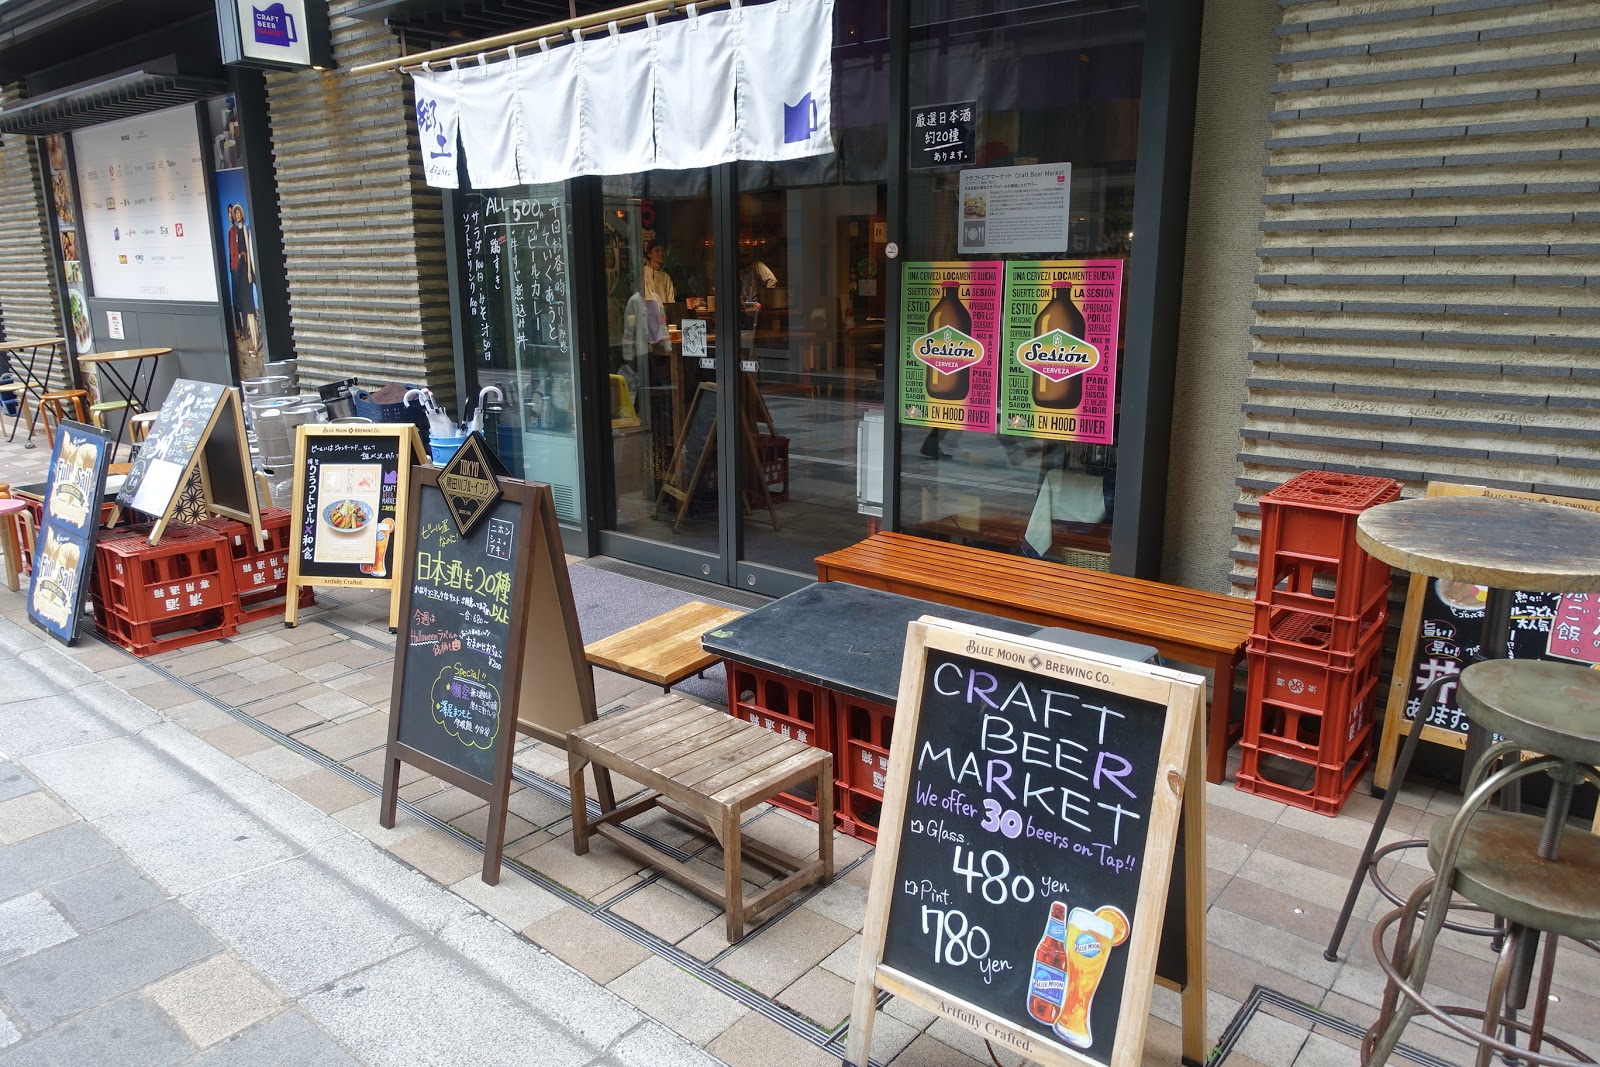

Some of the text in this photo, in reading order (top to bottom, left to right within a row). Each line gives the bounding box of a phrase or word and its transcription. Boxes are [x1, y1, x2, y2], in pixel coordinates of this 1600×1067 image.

[256, 13, 280, 23] CRAFT
[257, 20, 277, 30] BEER
[915, 107, 971, 128] 厳選日本酒
[924, 127, 960, 145] 約20種
[933, 149, 968, 162] あります。
[1014, 171, 1029, 179] Craft
[485, 197, 509, 217] ALL
[907, 271, 997, 281] UNA CERVEZA LOCAMENTE BUENA
[1012, 271, 1115, 281] UNA CERVEZA LOCAMENTE BUENA
[907, 287, 940, 296] SUERTE CON
[961, 288, 971, 297] LA
[1012, 288, 1050, 298] SUERTE CON
[1074, 287, 1115, 298] LA SESIÓN
[907, 301, 930, 313] ESTILO
[968, 302, 995, 311] APROBADA
[1011, 302, 1038, 315] ESTILO
[1081, 303, 1112, 313] APROBADA
[972, 312, 995, 320] POR LAS
[1087, 314, 1112, 323] POR LAS
[1009, 330, 1031, 338] SUPREMA
[919, 338, 976, 358] Sesión
[1024, 343, 1090, 364] Sesión
[935, 360, 959, 368] CERVEZA
[1009, 366, 1024, 374] ML
[972, 370, 992, 378] PARA
[1042, 367, 1070, 375] CERVEZA
[1008, 377, 1029, 389] CUELLO
[1085, 376, 1108, 385] PARA
[1008, 388, 1029, 396] CORTO
[969, 398, 991, 406] SABOR
[931, 405, 990, 424] EN HOOD RIVER
[1082, 406, 1107, 414] SABOR
[1037, 415, 1105, 435] EN HOOD RIVER
[460, 459, 480, 478] TOKYO
[56, 460, 72, 484] Full
[76, 467, 93, 497] Sail
[382, 485, 397, 493] CRAFT
[420, 518, 451, 540] ビール屋
[490, 524, 511, 536] ニホン
[39, 555, 76, 598] Full Sail
[252, 566, 286, 585] 清酒
[323, 578, 364, 586] Artfully Crafted.
[165, 592, 203, 612] 清酒
[413, 608, 436, 626] 今週は
[1516, 618, 1550, 632] 大人気
[1431, 640, 1460, 656] 早い!
[966, 639, 994, 658] BLUE
[997, 648, 1026, 665] MOON
[1045, 659, 1093, 681] BREWING
[933, 662, 1126, 745] CRAFT
[981, 713, 1137, 799] BEER
[917, 740, 1141, 845] MARKET
[915, 780, 1136, 875] We offer 30 beers on Tap!!
[952, 845, 1070, 905] 480 yen
[921, 904, 1013, 985] 780 yen
[1074, 942, 1101, 953] BLUE MOON
[1032, 978, 1065, 988] BLUE MOON
[937, 1001, 1034, 1054] Artfully Crafted.
